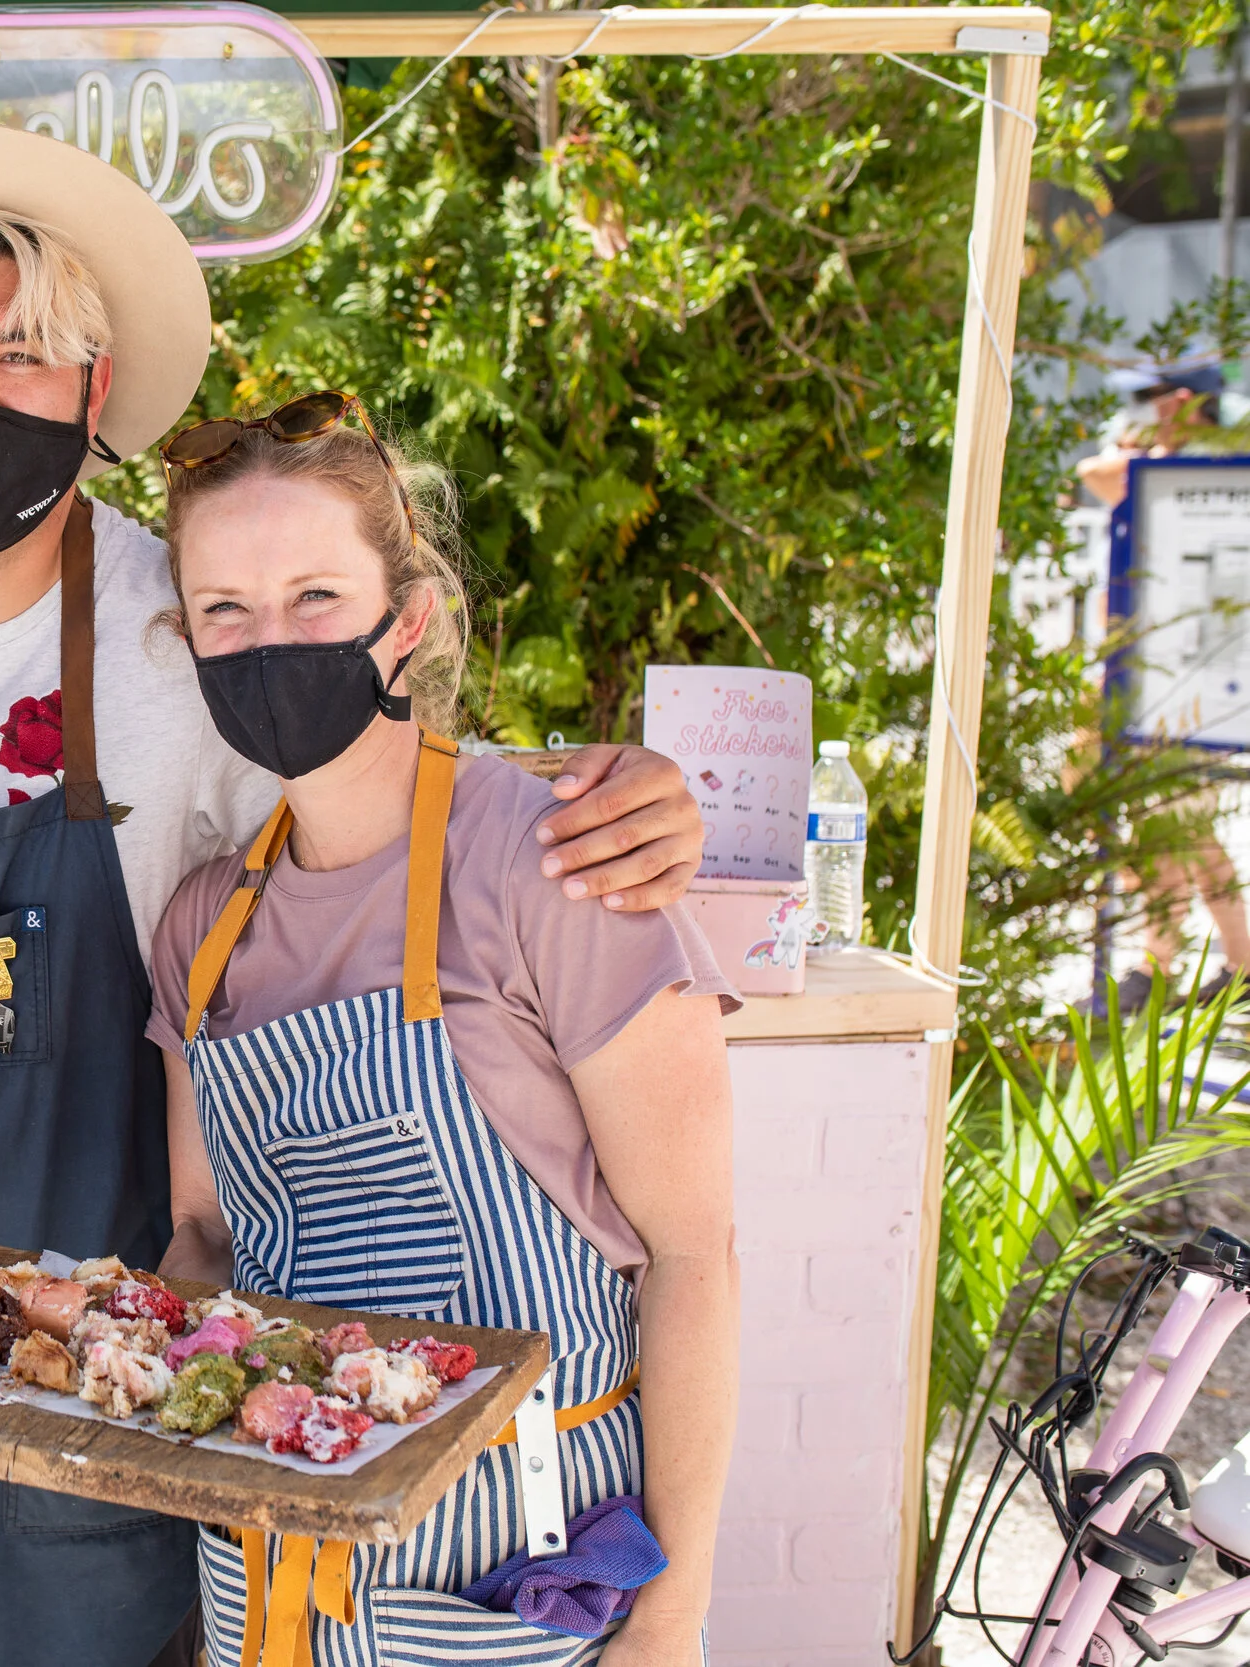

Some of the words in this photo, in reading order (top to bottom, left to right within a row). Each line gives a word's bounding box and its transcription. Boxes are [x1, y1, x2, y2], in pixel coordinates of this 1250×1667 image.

[712, 689, 789, 722] Free
[26, 911, 41, 928] &
[396, 1119, 414, 1137] &
